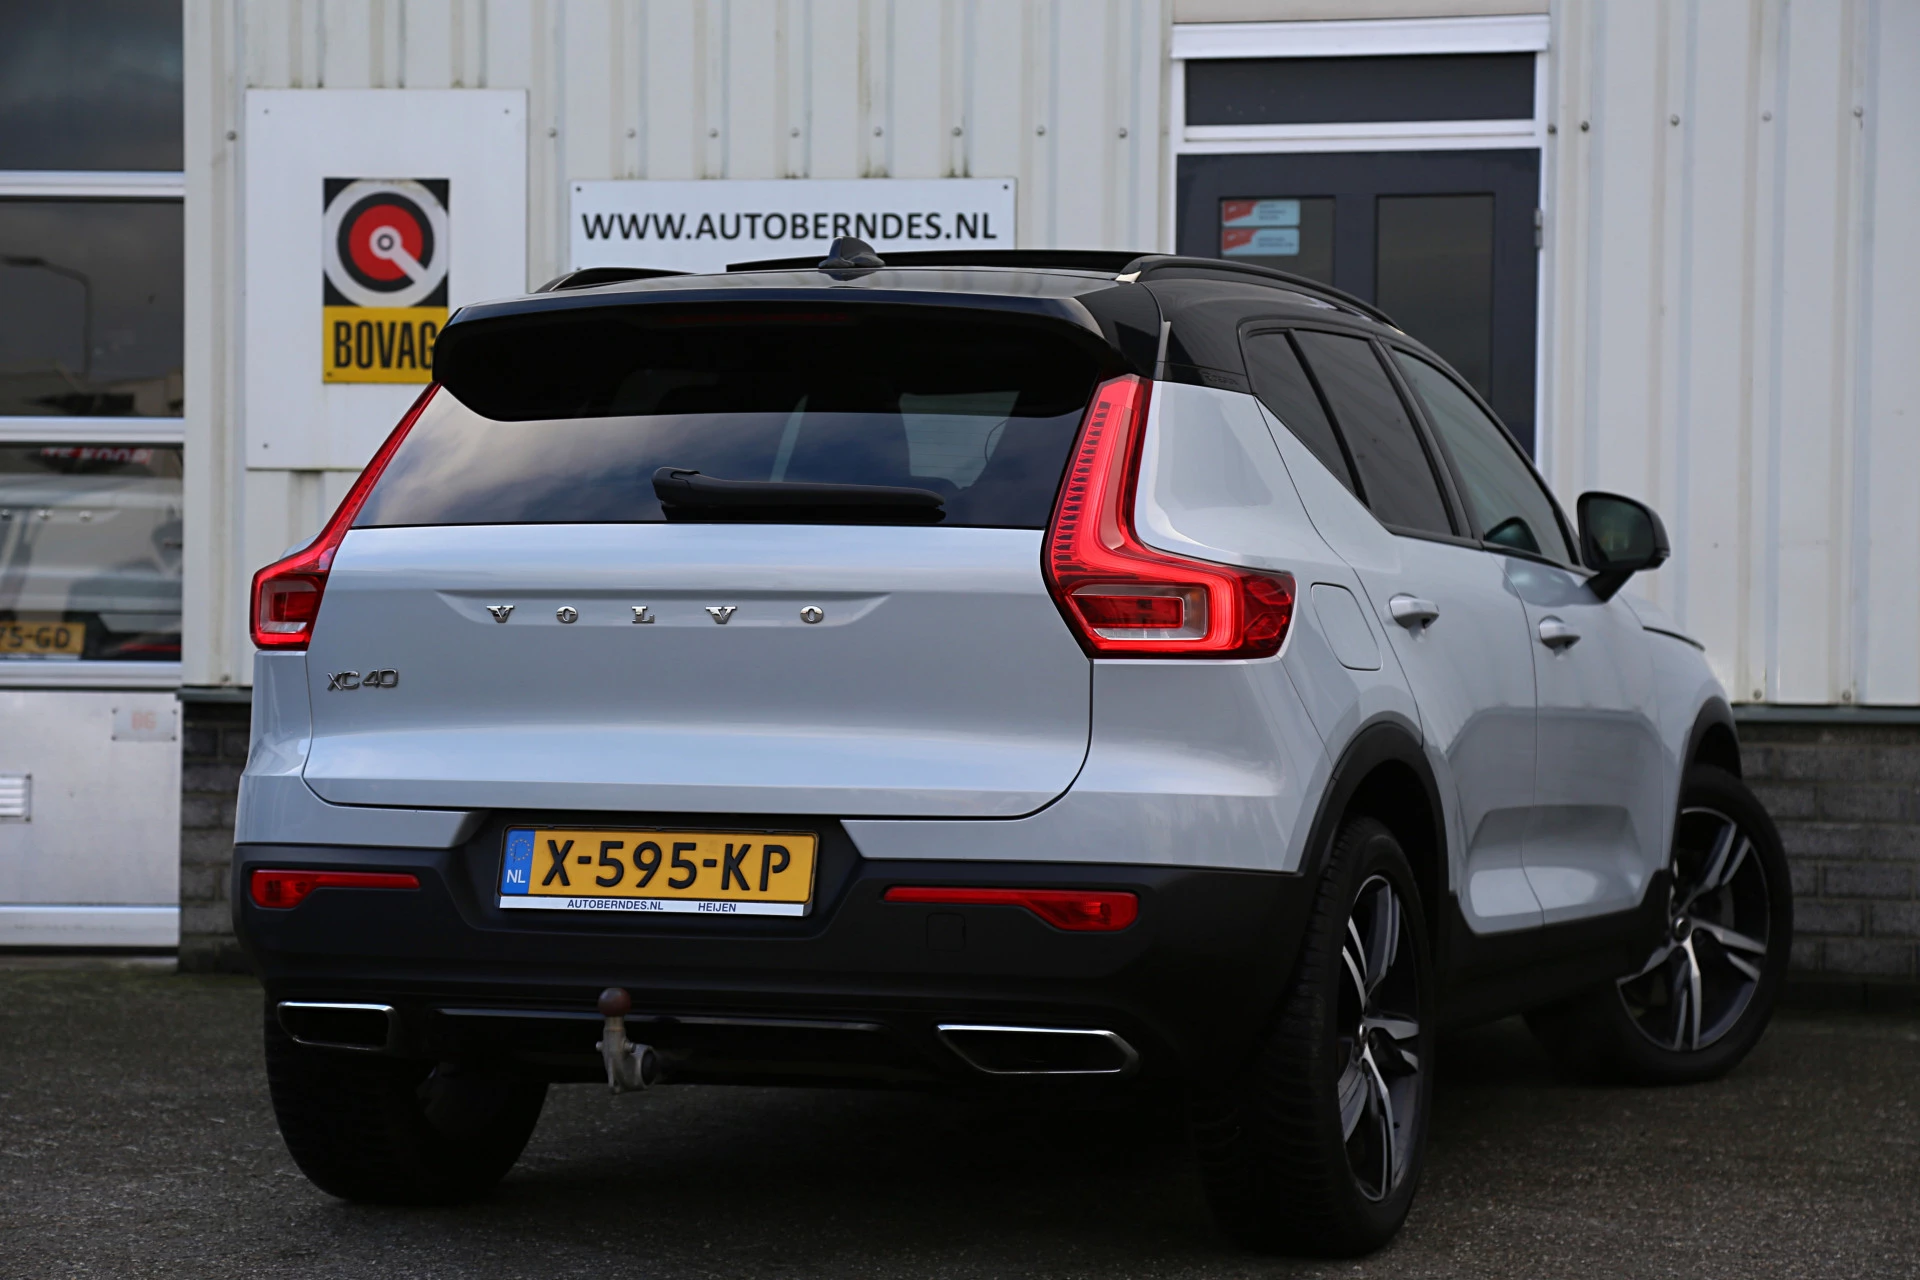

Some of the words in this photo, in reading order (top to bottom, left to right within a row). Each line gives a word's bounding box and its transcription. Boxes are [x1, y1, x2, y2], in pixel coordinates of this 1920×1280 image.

[582, 213, 998, 240] WWW.AUTOBERNDES.NL
[333, 320, 437, 369] BOVAG
[486, 605, 824, 624] VOLVO
[327, 668, 399, 691] XC40
[507, 869, 526, 884] NL
[541, 840, 791, 891] X-595-KP
[567, 899, 664, 911] AUTOBERNDES.NL
[698, 902, 737, 913] HEIJEN
